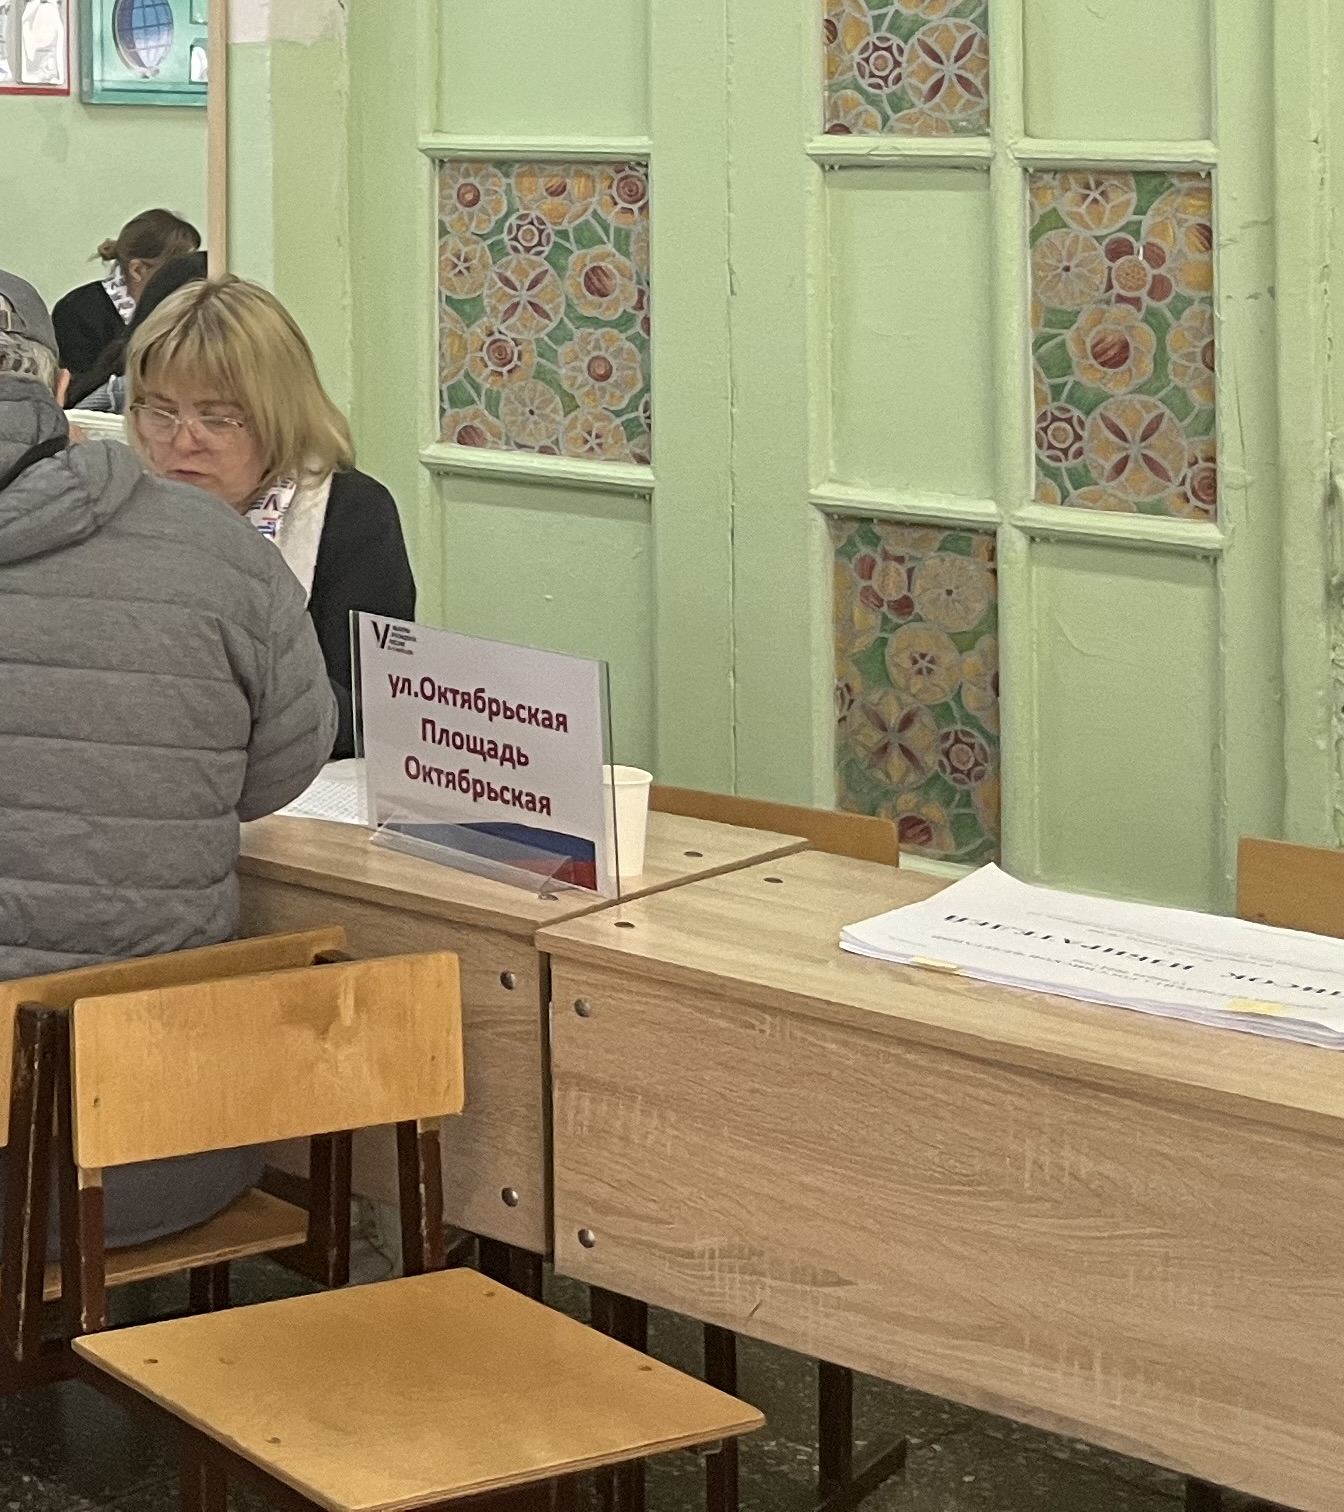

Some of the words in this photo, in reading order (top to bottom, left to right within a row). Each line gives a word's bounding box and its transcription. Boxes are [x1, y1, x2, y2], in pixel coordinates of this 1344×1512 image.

[387, 673, 569, 733] ул.Октябрьская
[421, 717, 530, 770] Площадь
[404, 755, 552, 817] Октябрьская
